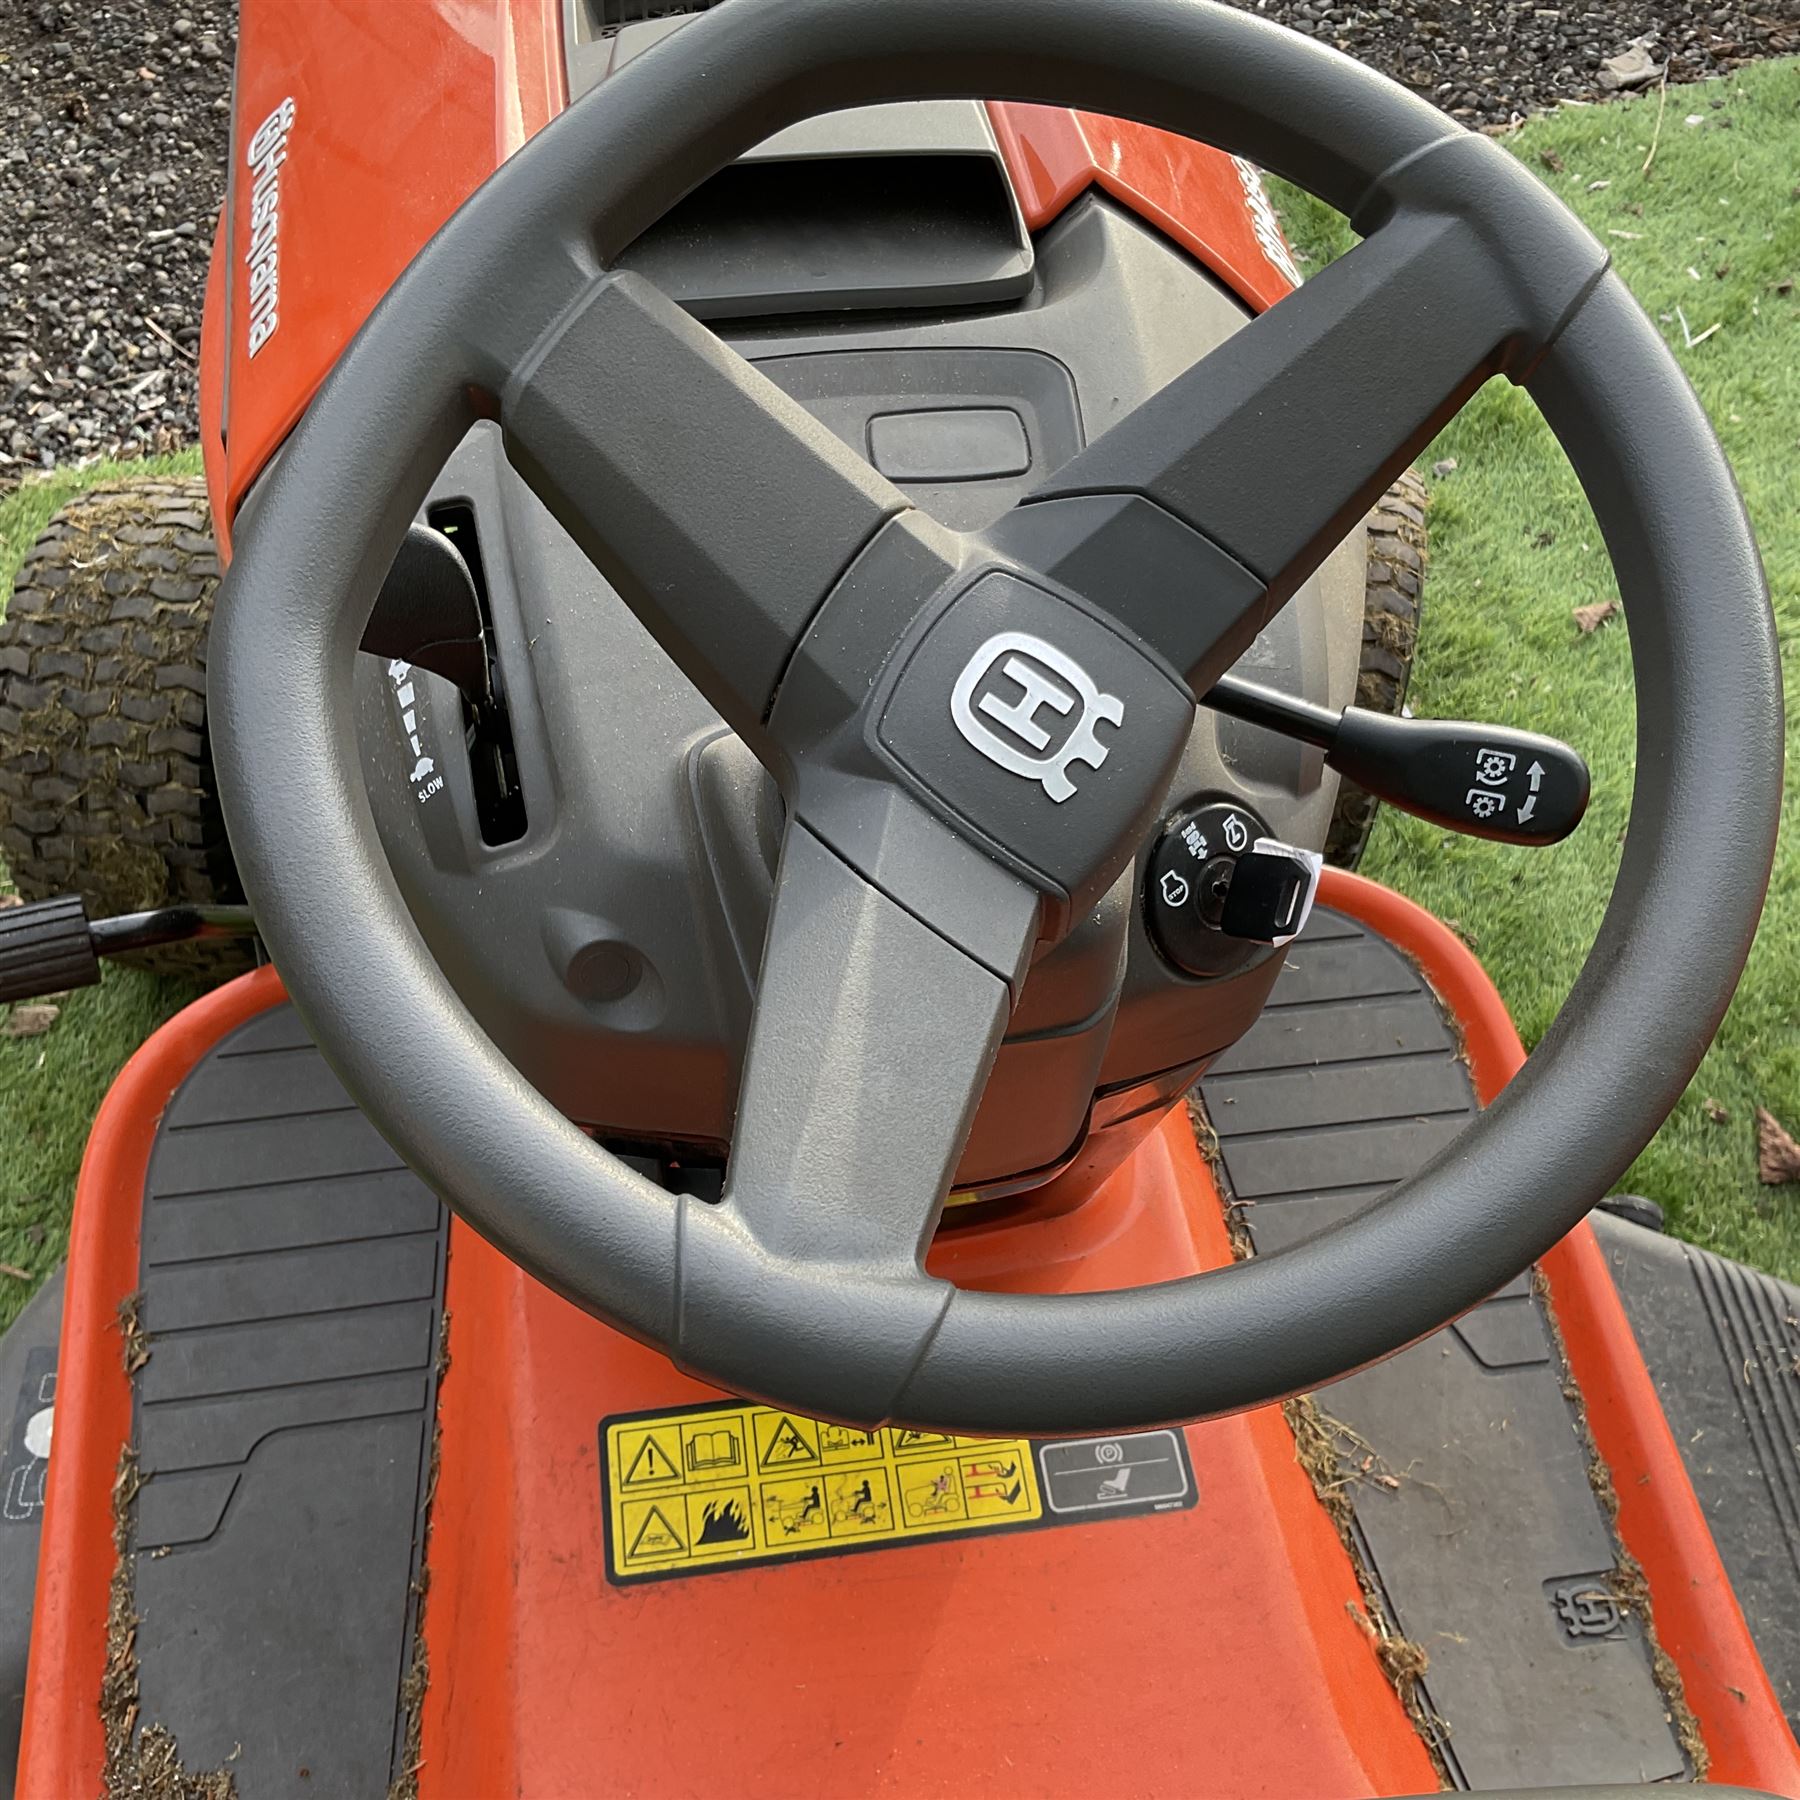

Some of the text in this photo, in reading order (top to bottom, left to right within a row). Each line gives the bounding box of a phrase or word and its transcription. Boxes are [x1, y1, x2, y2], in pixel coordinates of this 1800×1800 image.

[245, 134, 287, 359] Husqvarna
[418, 775, 444, 803] SLOW
[1168, 885, 1184, 900] STOP
